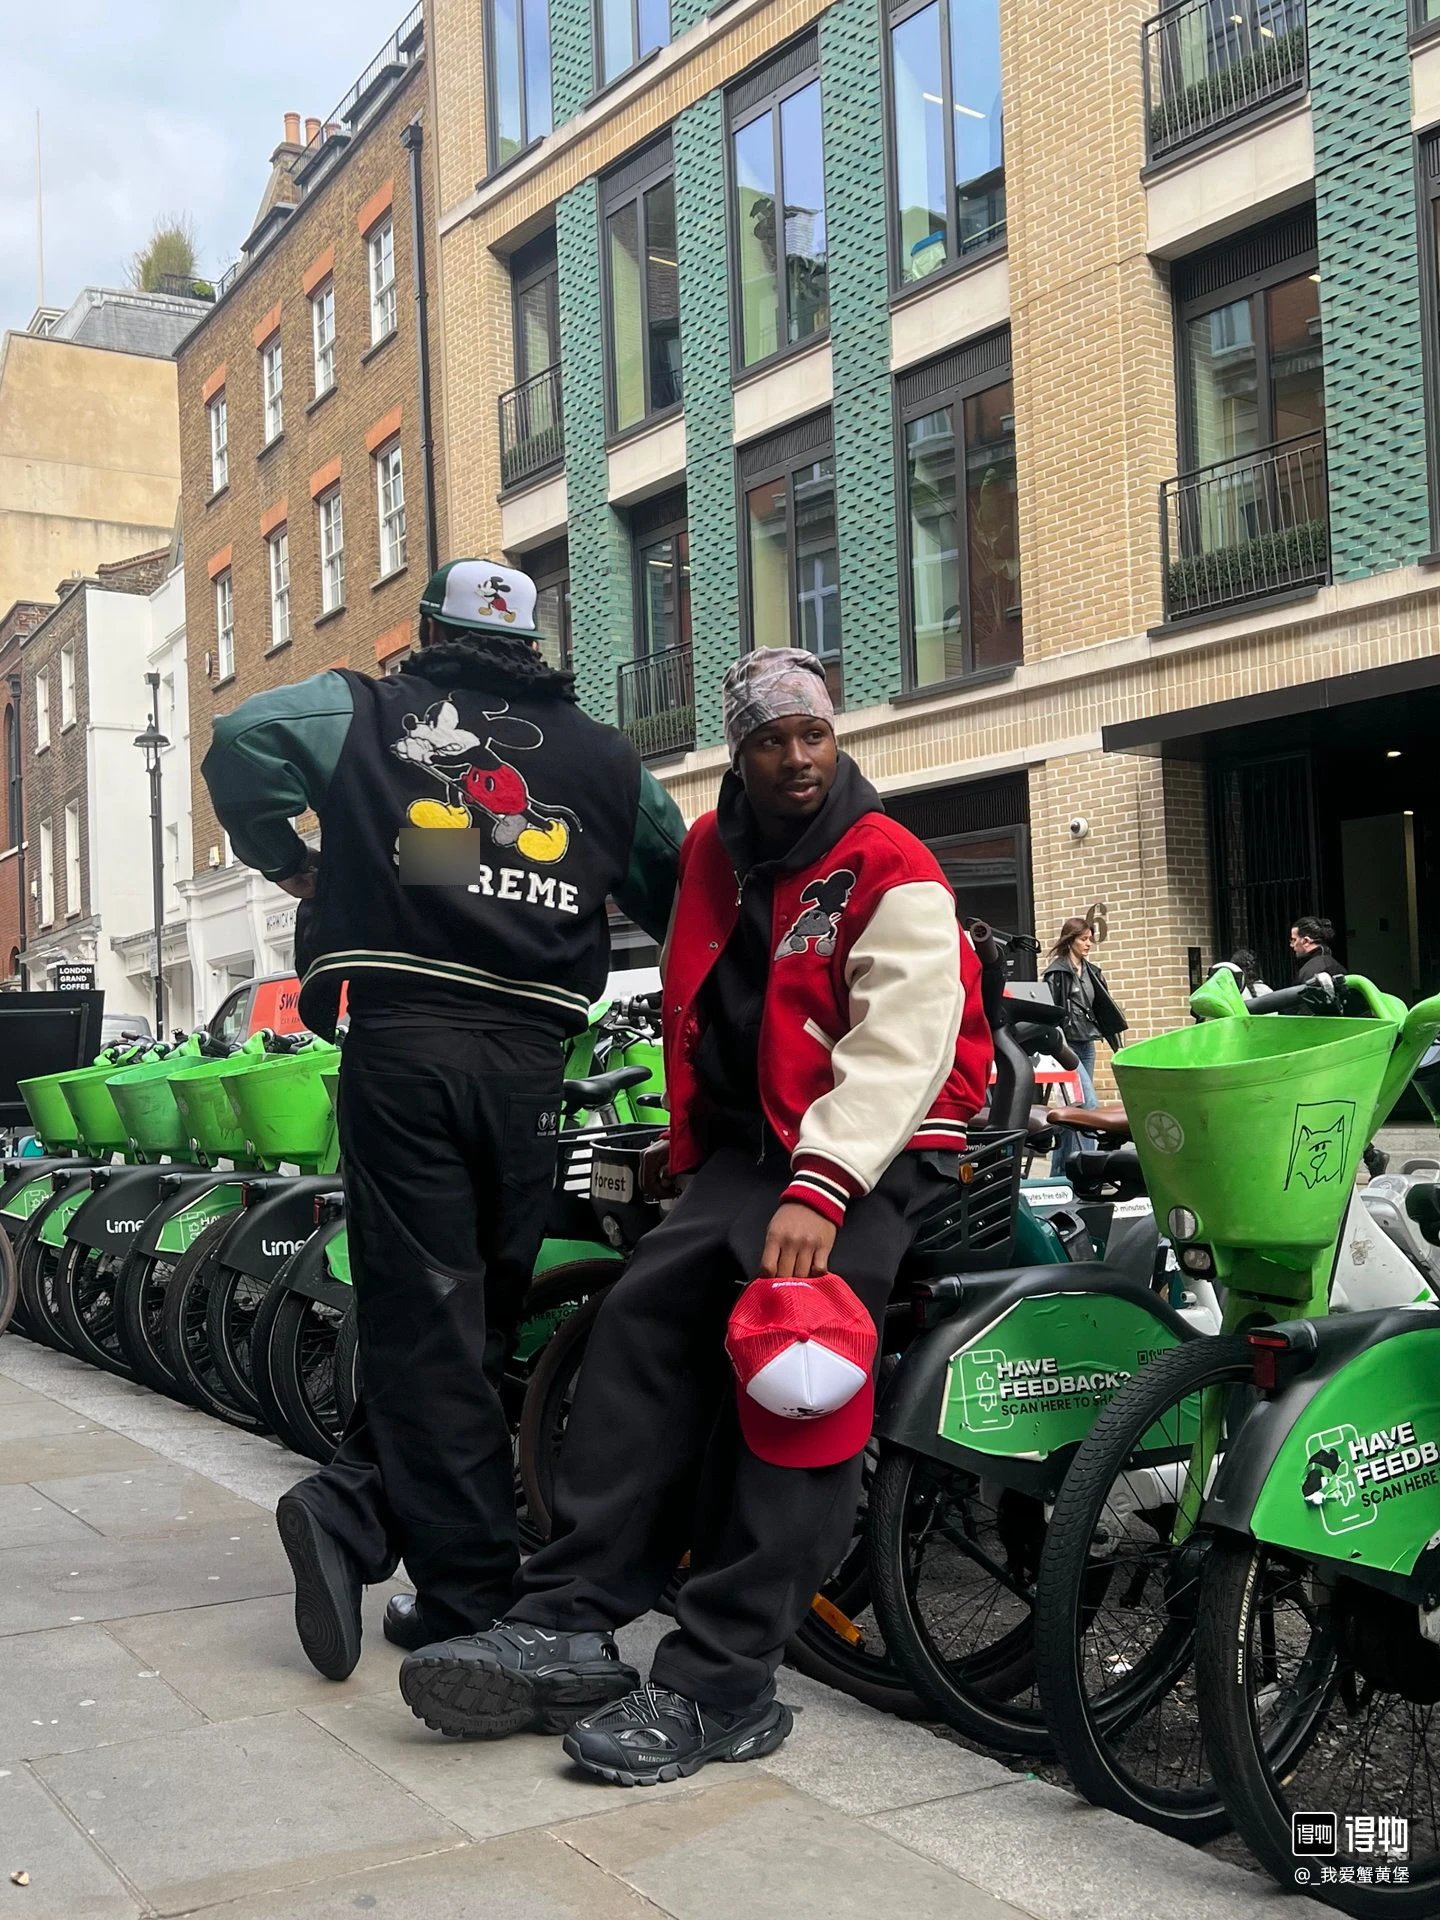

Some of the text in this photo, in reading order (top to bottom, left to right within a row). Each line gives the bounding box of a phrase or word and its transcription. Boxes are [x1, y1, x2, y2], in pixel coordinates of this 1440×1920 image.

[468, 864, 579, 915] REME
[1086, 902, 1108, 945] 6
[280, 992, 300, 1010] SWI
[594, 1172, 626, 1191] forest
[1120, 1204, 1146, 1212] minutes
[996, 1357, 1059, 1379] HAVE
[999, 1370, 1132, 1400] FEEDBACK?
[1001, 1402, 1038, 1416] SCAN
[1040, 1400, 1072, 1413] HERE
[1075, 1397, 1091, 1409] TO
[1348, 1421, 1417, 1462] HAVE
[1353, 1441, 1440, 1488] FEEDB
[1361, 1469, 1439, 1508] SCAN HERE
